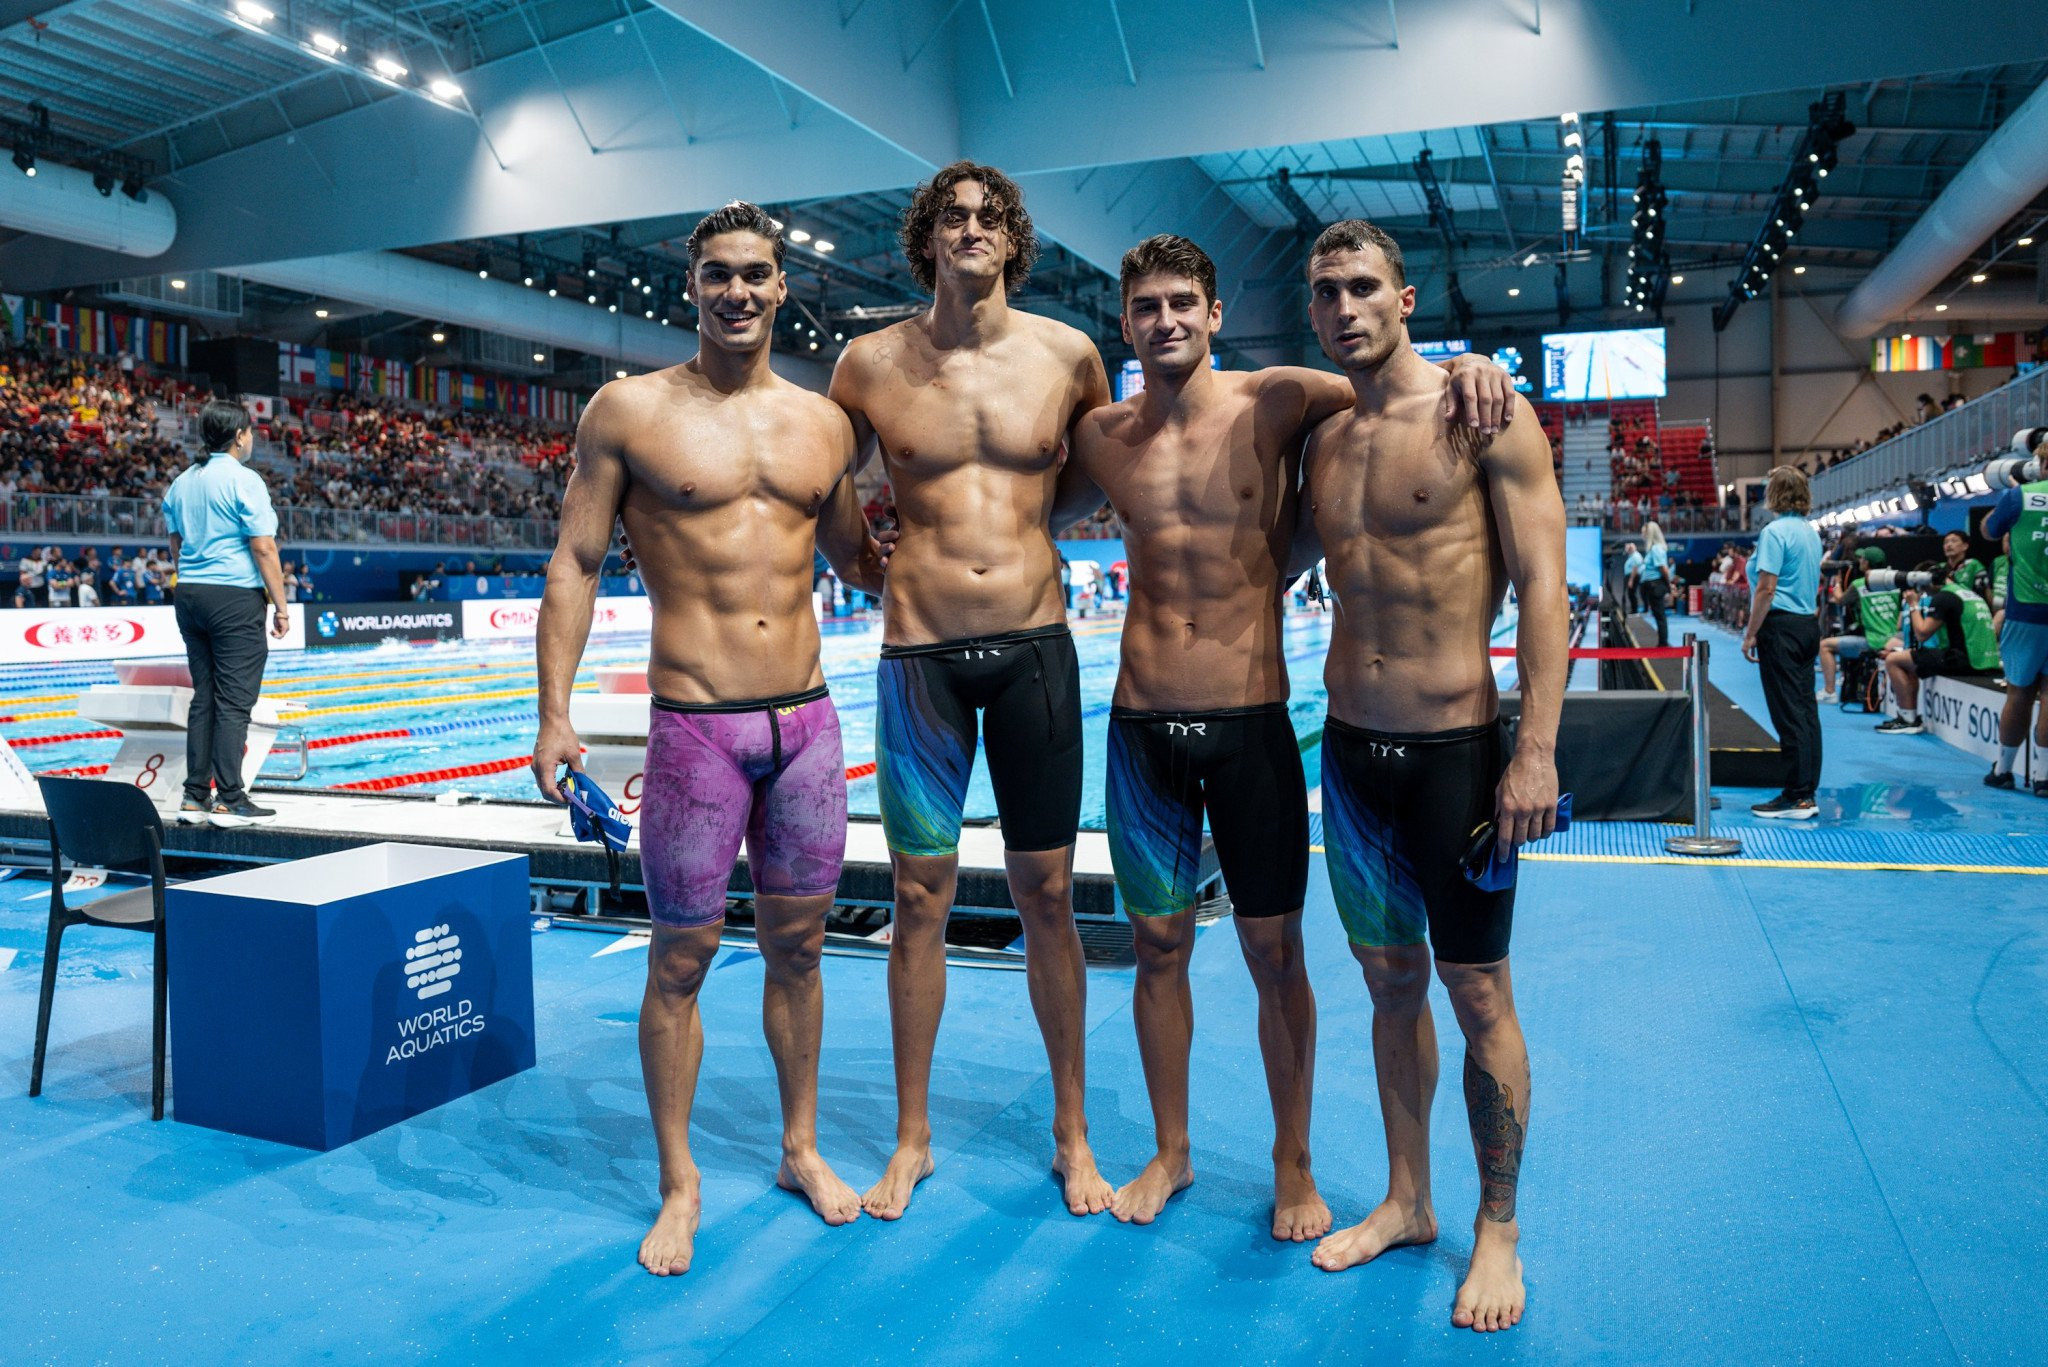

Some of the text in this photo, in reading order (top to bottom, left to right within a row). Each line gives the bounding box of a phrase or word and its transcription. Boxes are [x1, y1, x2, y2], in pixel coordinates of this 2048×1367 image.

[342, 613, 453, 631] WORLD AQUATICS
[1925, 688, 1963, 730] SONY
[1166, 722, 1206, 736] TYR
[135, 753, 165, 789] 8
[398, 1000, 473, 1038] WORLD
[385, 1015, 485, 1065] AQUATICS
